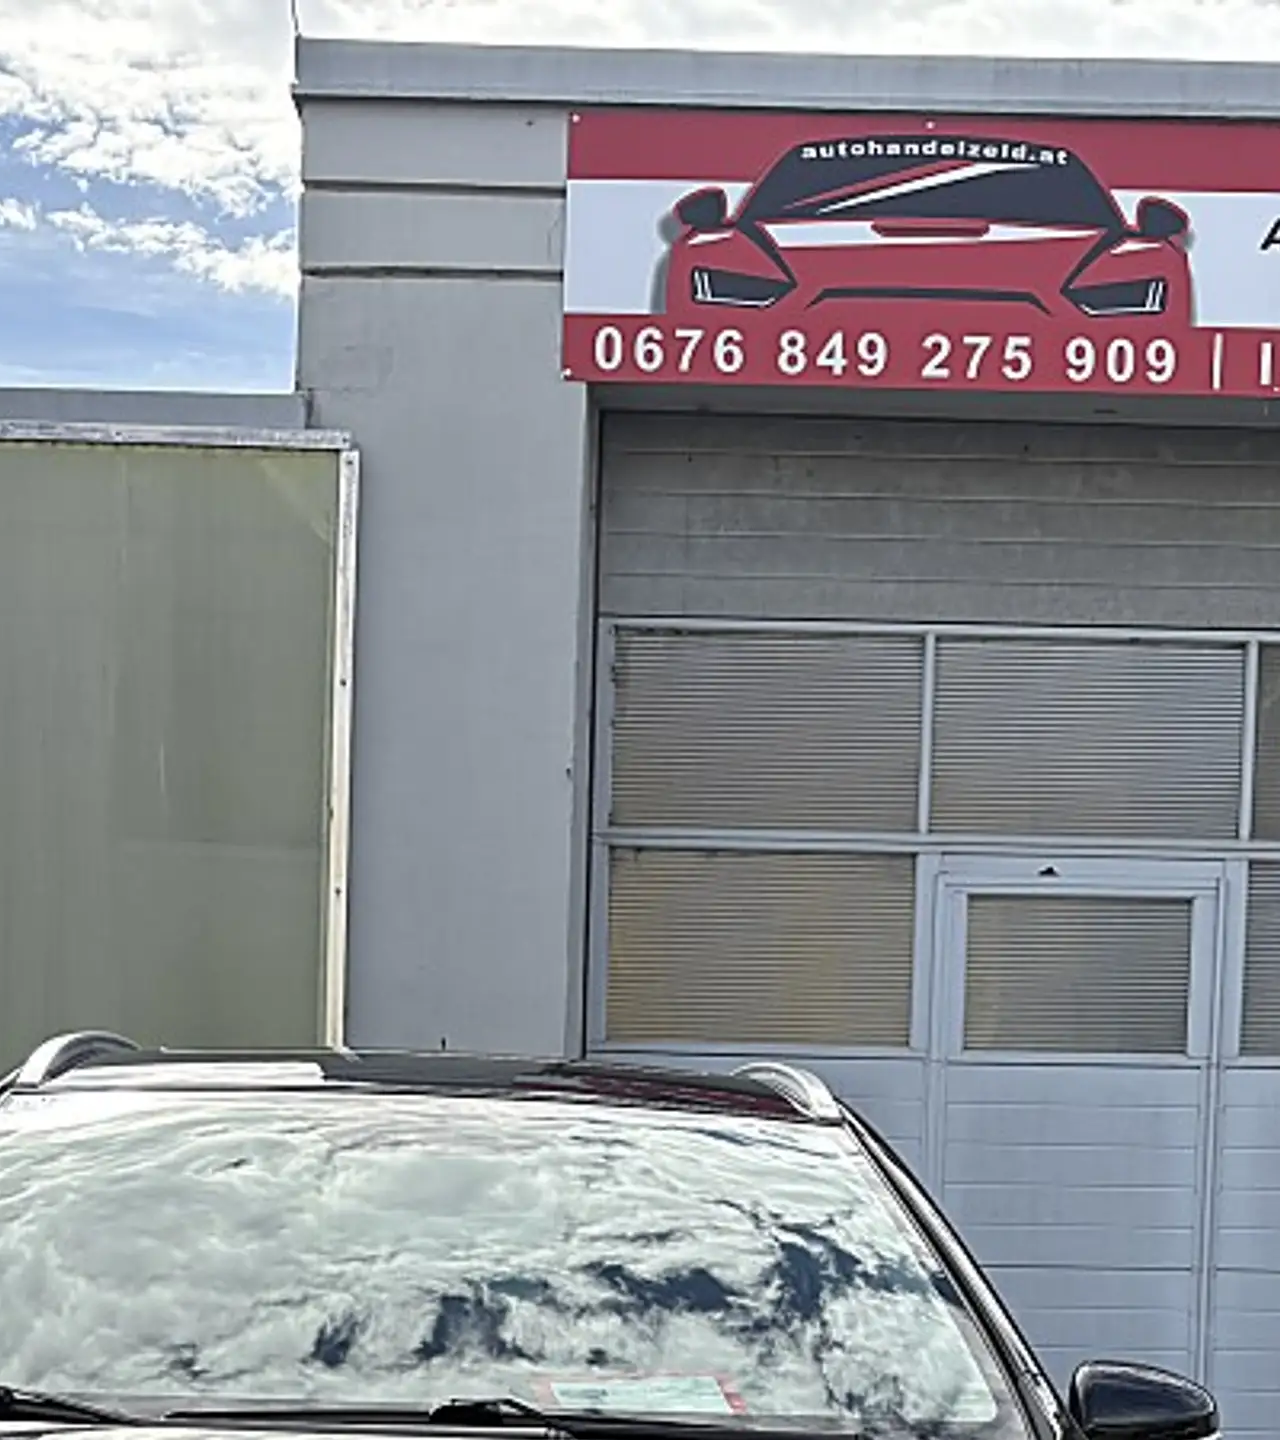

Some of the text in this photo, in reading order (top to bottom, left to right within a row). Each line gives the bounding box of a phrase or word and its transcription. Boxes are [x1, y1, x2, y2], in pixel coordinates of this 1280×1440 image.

[801, 140, 1069, 166] autohandelzeid.at
[593, 326, 746, 374] 0676
[776, 332, 889, 377] 849
[920, 334, 1034, 380] 275
[1064, 340, 1177, 383] 909
